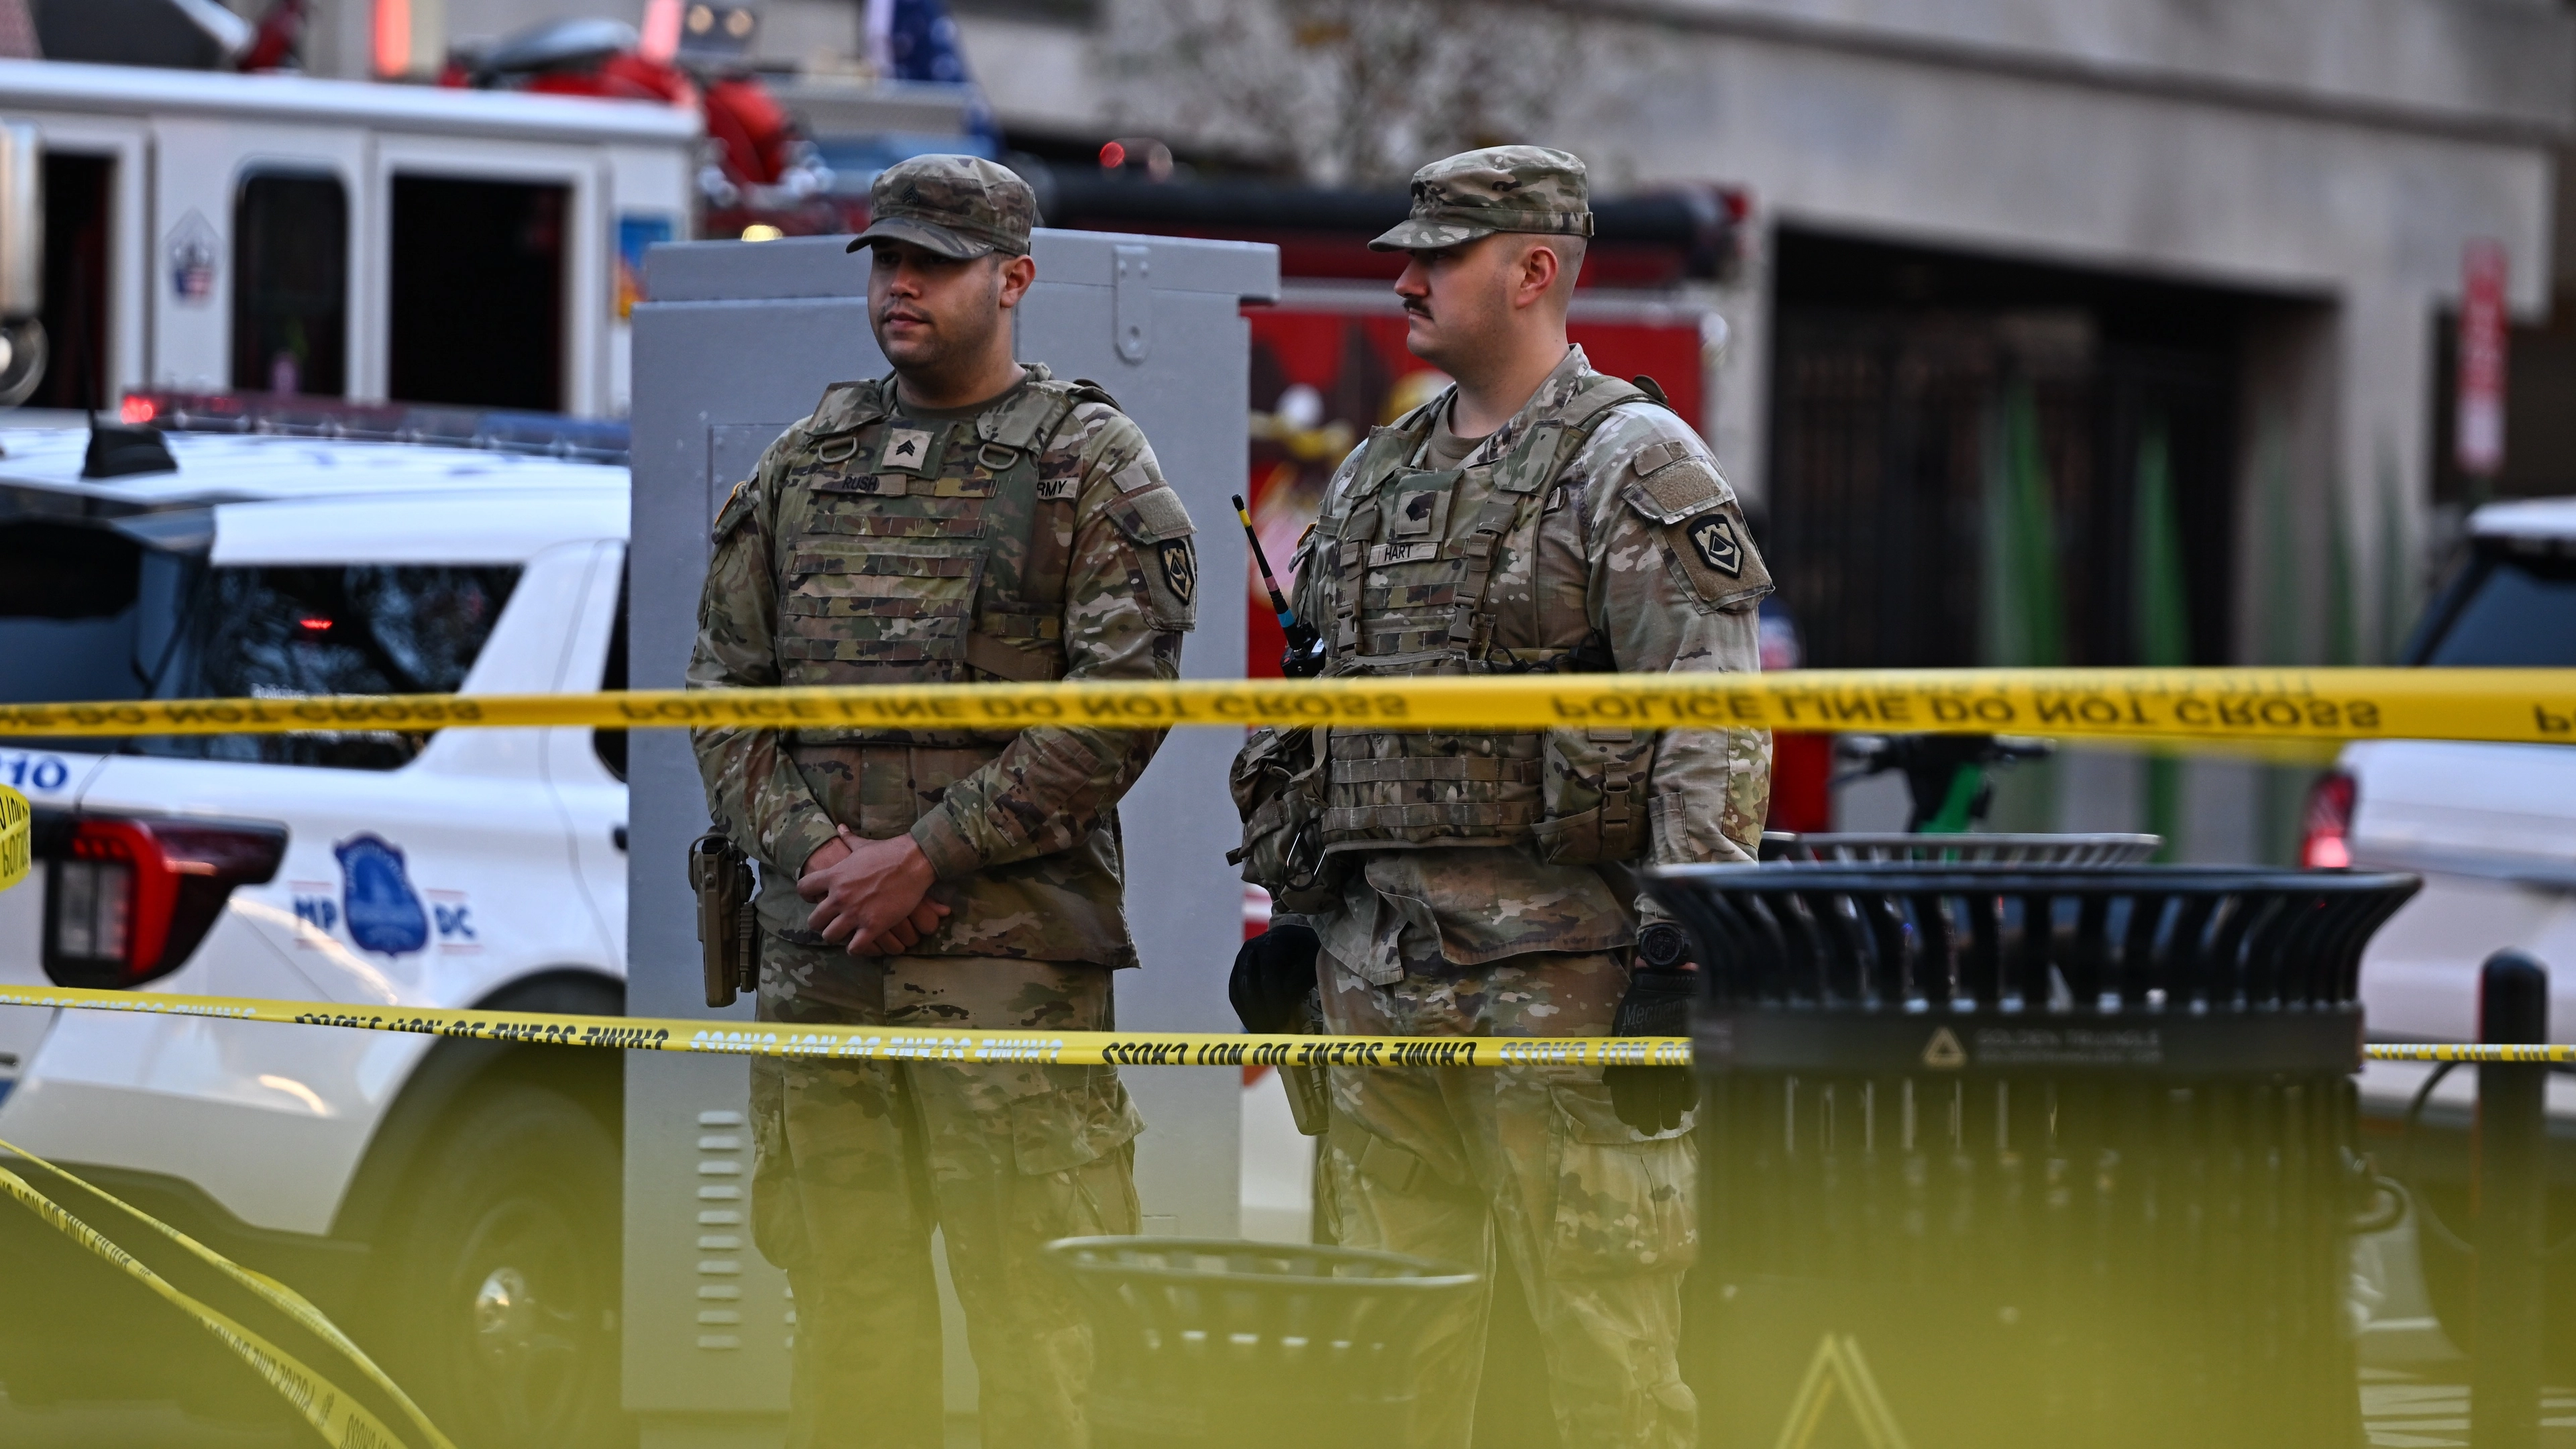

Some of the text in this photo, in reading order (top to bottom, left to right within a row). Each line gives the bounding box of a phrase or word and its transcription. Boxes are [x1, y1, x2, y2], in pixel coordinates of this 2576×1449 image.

[842, 476, 878, 491] RUSH
[1036, 480, 1068, 496] RMY
[1384, 543, 1413, 561] HART
[0, 753, 69, 792] 10
[1622, 998, 1690, 1027] Mechan
[1102, 1041, 1478, 1066] CRIME SCENE DO NOT CROSS
